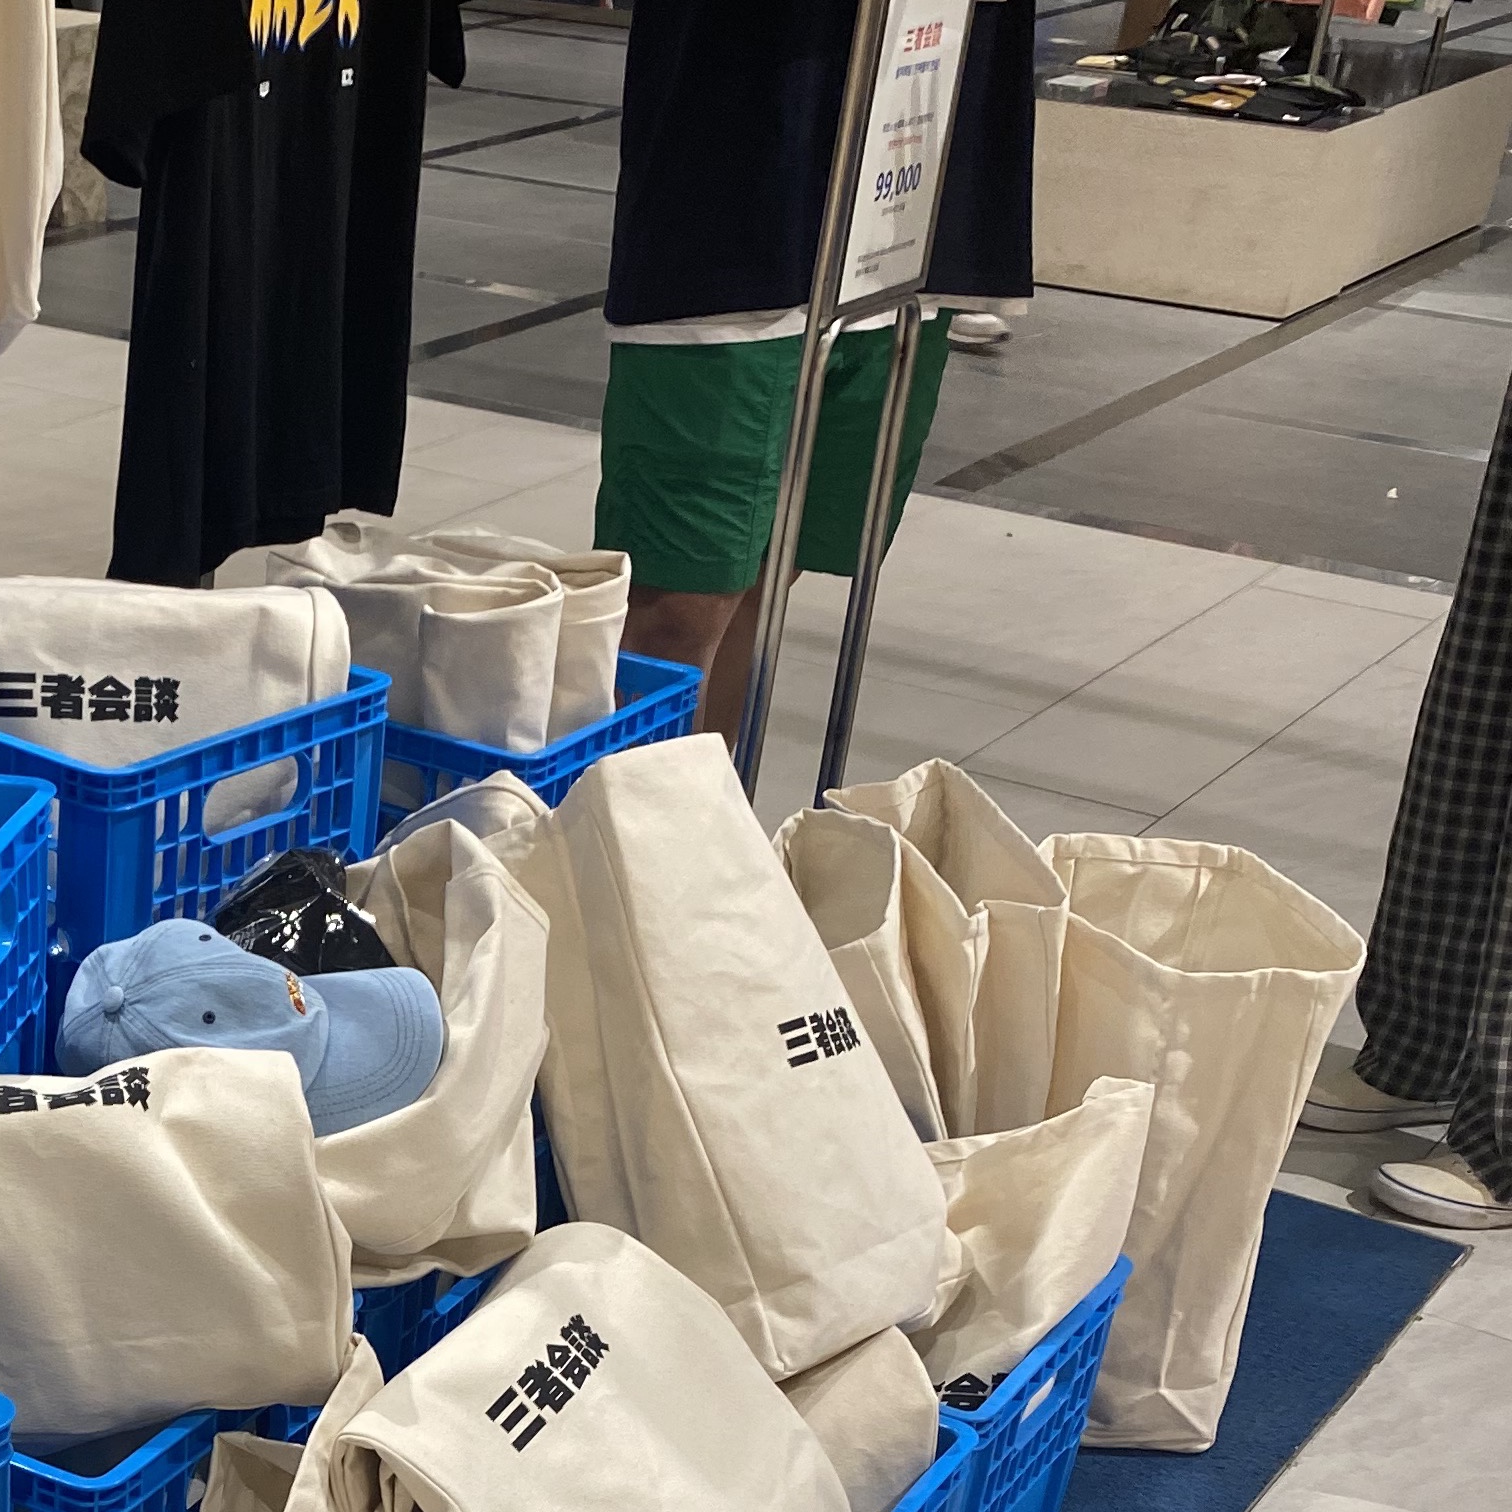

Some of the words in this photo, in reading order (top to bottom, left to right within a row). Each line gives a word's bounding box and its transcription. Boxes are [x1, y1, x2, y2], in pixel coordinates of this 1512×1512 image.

[874, 162, 921, 202] 99,000
[777, 1006, 861, 1069] 三者会談
[485, 1314, 610, 1453] 三者会談
